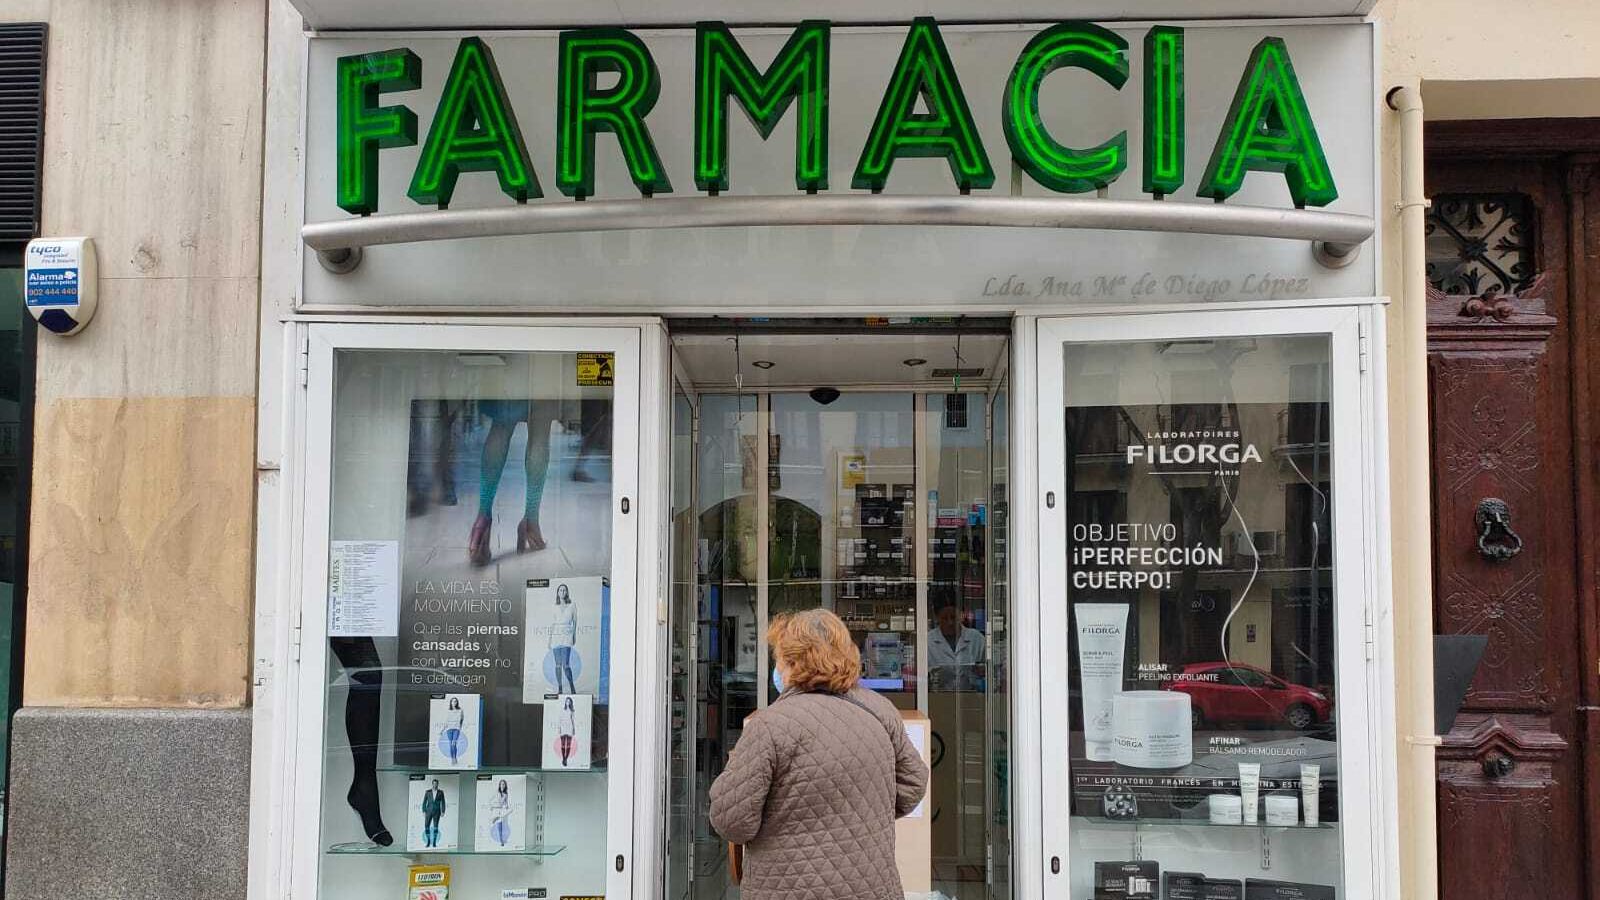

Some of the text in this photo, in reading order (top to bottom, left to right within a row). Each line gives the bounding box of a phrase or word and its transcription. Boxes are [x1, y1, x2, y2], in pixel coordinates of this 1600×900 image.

[336, 16, 1338, 215] FARMACIA
[30, 246, 61, 255] tyco
[29, 272, 64, 280] Alarma
[982, 275, 1030, 297] Lda.
[1036, 275, 1081, 298] Ana
[1131, 272, 1157, 299] de
[1163, 275, 1231, 302] Diego
[1239, 273, 1308, 298] López
[1147, 431, 1240, 439] LABORATOIRES
[1127, 444, 1263, 465] FILORGA
[1073, 523, 1177, 542] OBJETIVO
[1073, 543, 1223, 566] ¡PERFECCIÓN
[415, 580, 499, 595] LA VIDA ES
[1073, 571, 1172, 590] CUERPO!
[414, 599, 512, 613] MOVIMIENTO
[413, 622, 518, 637] Que las piernas
[412, 639, 492, 653] cansadas y
[411, 656, 511, 668] con varices no
[1138, 663, 1168, 672] ALISAR
[1138, 673, 1220, 683] PEELING EXFOLIANTE
[1209, 737, 1241, 745] AFINAR
[1248, 747, 1307, 756] REMODELADOR
[1094, 777, 1154, 786] LABORATORIO
[1161, 777, 1201, 787] FRANCÉS
